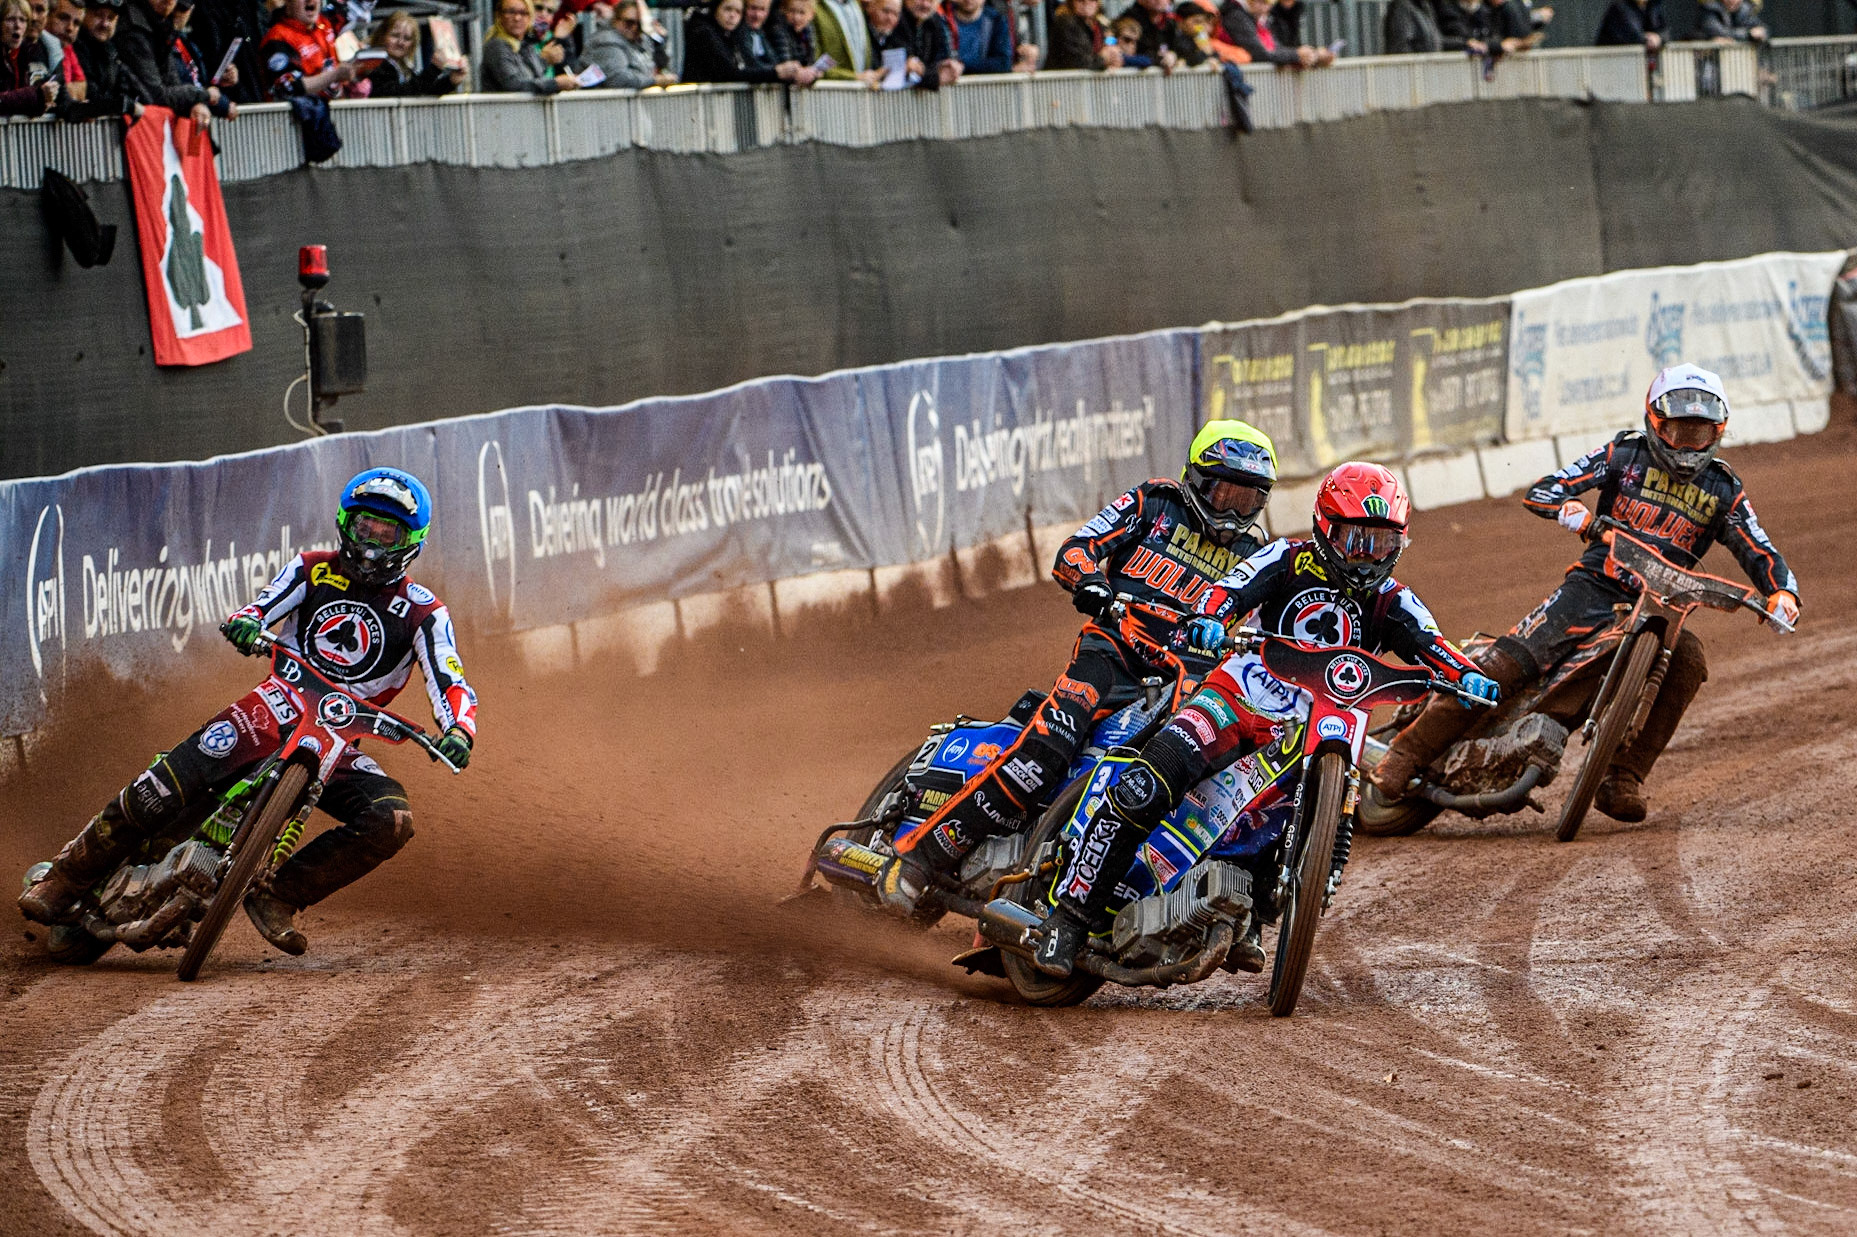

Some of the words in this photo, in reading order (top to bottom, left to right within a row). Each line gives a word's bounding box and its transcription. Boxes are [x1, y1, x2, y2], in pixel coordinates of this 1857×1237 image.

[605, 472, 664, 547] world
[82, 545, 194, 654] Delivering
[190, 539, 239, 626] what
[316, 604, 347, 623] BELLE
[365, 618, 381, 645] ACES
[1294, 592, 1326, 610] BELLE
[1329, 594, 1354, 612] VUE
[1350, 613, 1361, 640] ACES
[267, 689, 296, 721] FTS
[1168, 723, 1202, 754] DOCUFY
[1322, 723, 1342, 733] ATPI
[914, 742, 938, 764] 2
[1007, 761, 1027, 781] ROCK
[1025, 776, 1039, 791] OIL
[1091, 765, 1113, 794] 3
